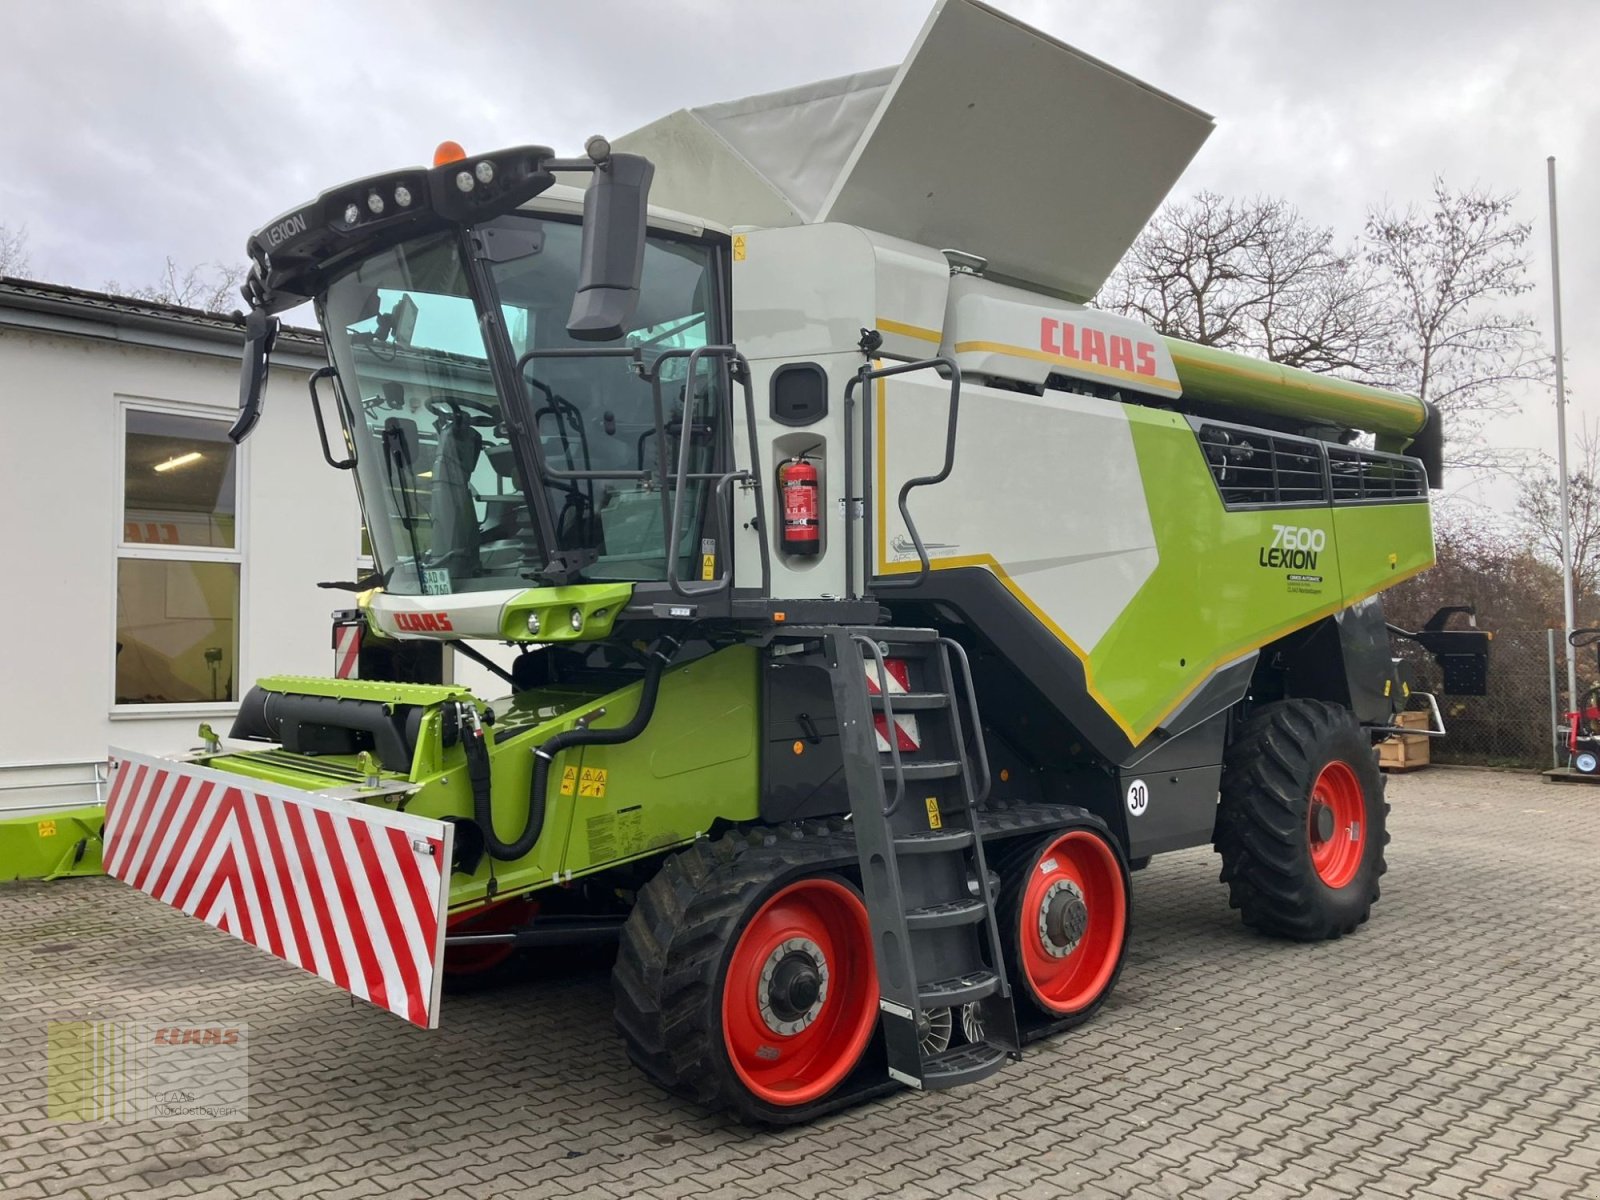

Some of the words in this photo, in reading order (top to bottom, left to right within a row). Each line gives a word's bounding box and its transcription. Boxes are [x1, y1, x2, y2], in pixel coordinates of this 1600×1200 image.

[266, 214, 307, 247] LEXION
[1041, 317, 1156, 377] CLAAS
[1271, 524, 1326, 552] 7600
[1259, 547, 1317, 570] LEXION
[393, 612, 454, 632] CLAAS
[1131, 786, 1145, 810] 30
